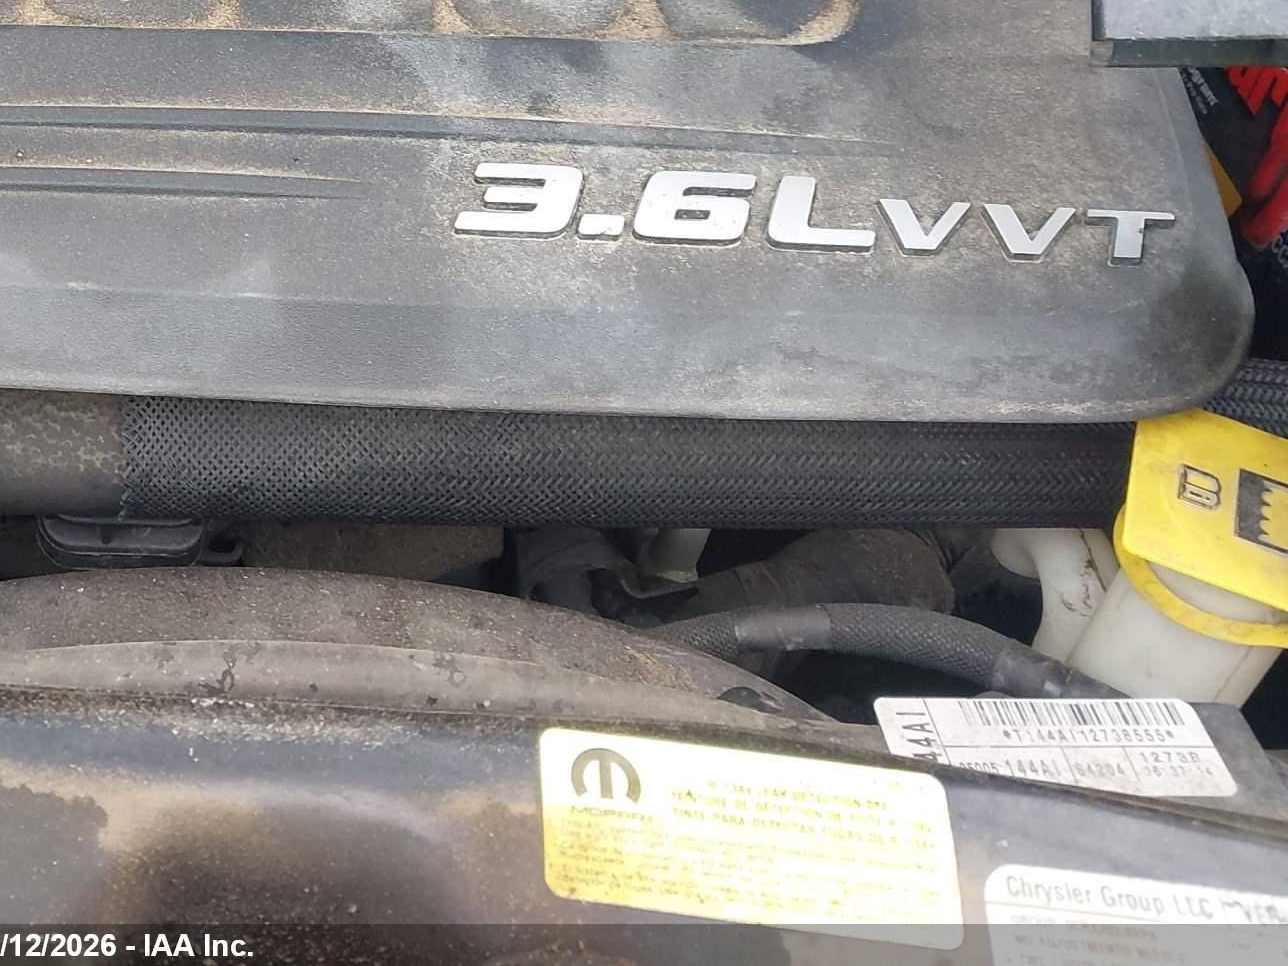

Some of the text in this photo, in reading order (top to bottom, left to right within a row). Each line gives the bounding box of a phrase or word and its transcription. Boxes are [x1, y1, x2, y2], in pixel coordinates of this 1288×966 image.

[453, 161, 1178, 268] 3.6L VVT
[1005, 875, 1091, 906] Chrysler
[1100, 884, 1165, 916] Group
[1172, 893, 1215, 920] LLC
